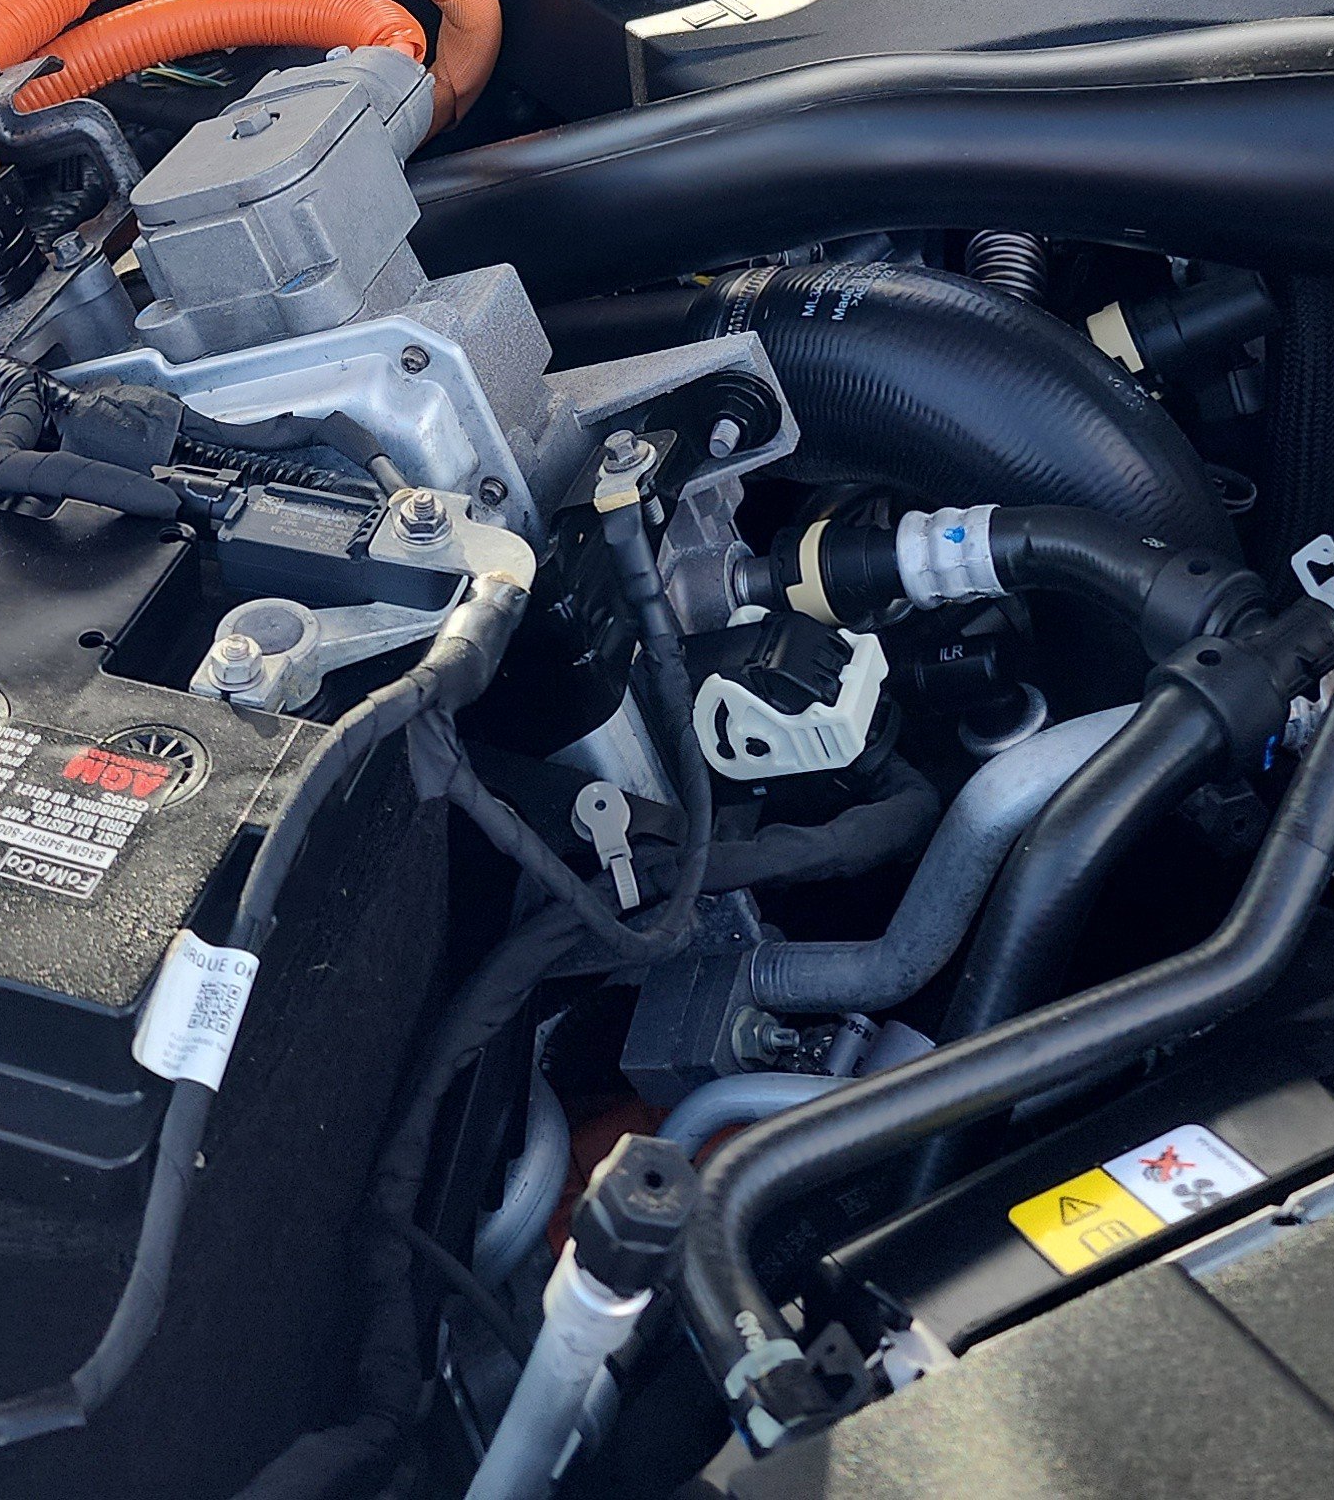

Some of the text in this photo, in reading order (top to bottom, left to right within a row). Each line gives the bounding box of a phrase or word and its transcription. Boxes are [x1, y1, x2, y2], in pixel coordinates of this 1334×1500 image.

[65, 757, 162, 796] AGM
[51, 805, 99, 826] MOTOR
[97, 817, 134, 835] FORD
[71, 825, 93, 839] BY
[6, 855, 95, 891] FoMoCo
